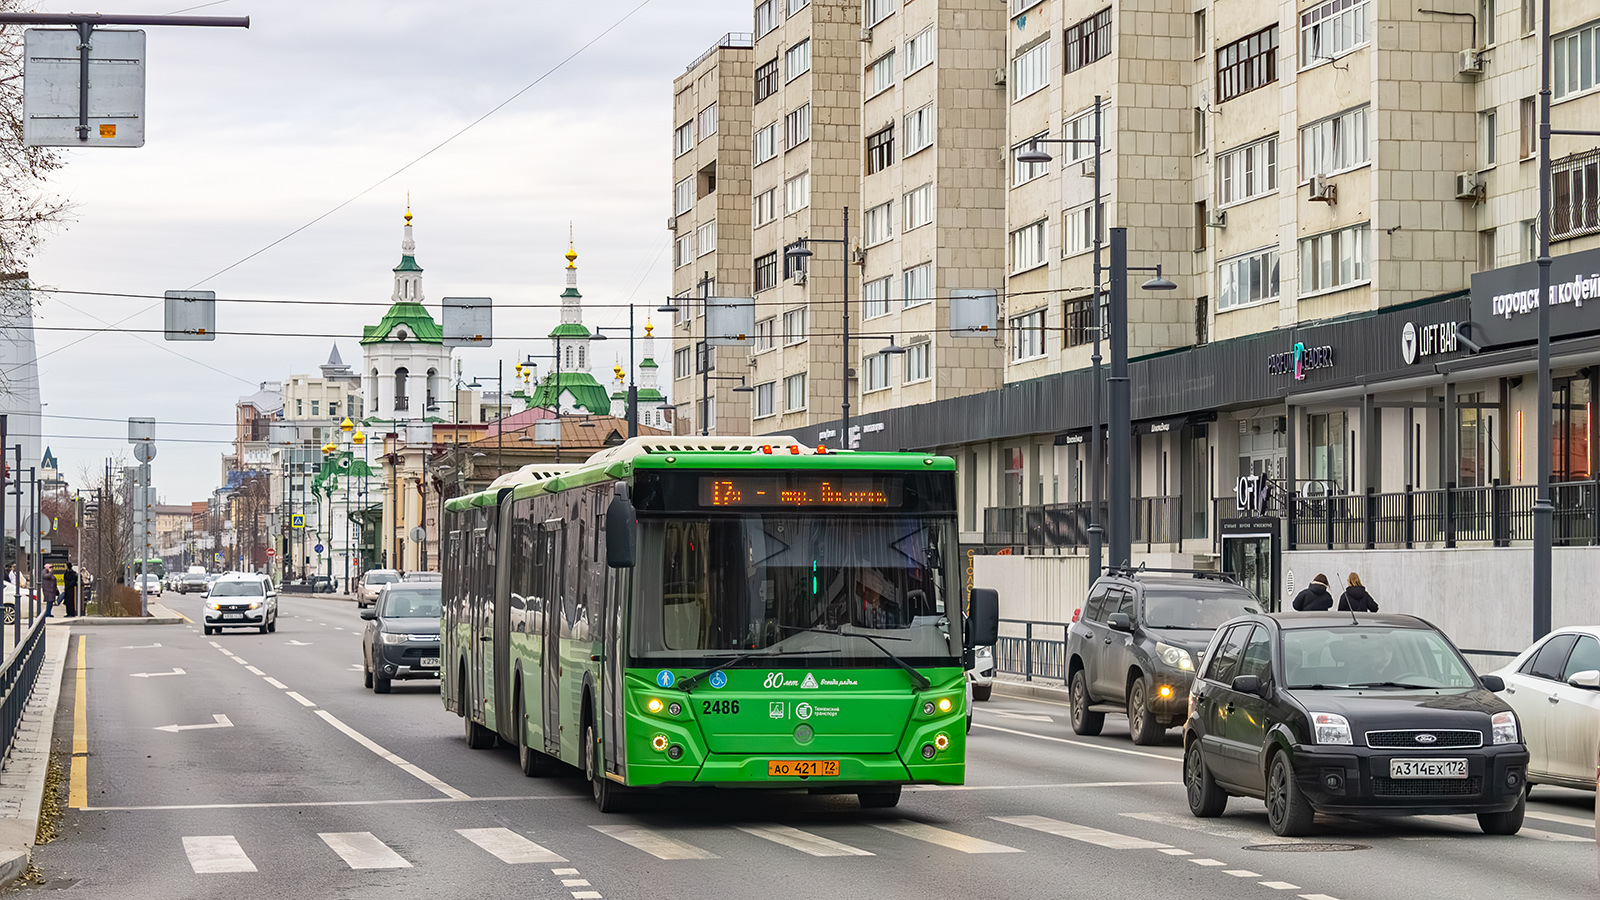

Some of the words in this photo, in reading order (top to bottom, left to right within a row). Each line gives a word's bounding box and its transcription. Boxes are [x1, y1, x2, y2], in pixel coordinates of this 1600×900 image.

[1492, 285, 1558, 319] городскя
[1419, 324, 1438, 356] LOFT
[1440, 321, 1457, 353] BAR
[1268, 351, 1294, 375] PARFUM
[763, 671, 784, 689] 80
[702, 700, 740, 715] 2486
[794, 762, 817, 774] 421
[824, 761, 836, 771] 72
